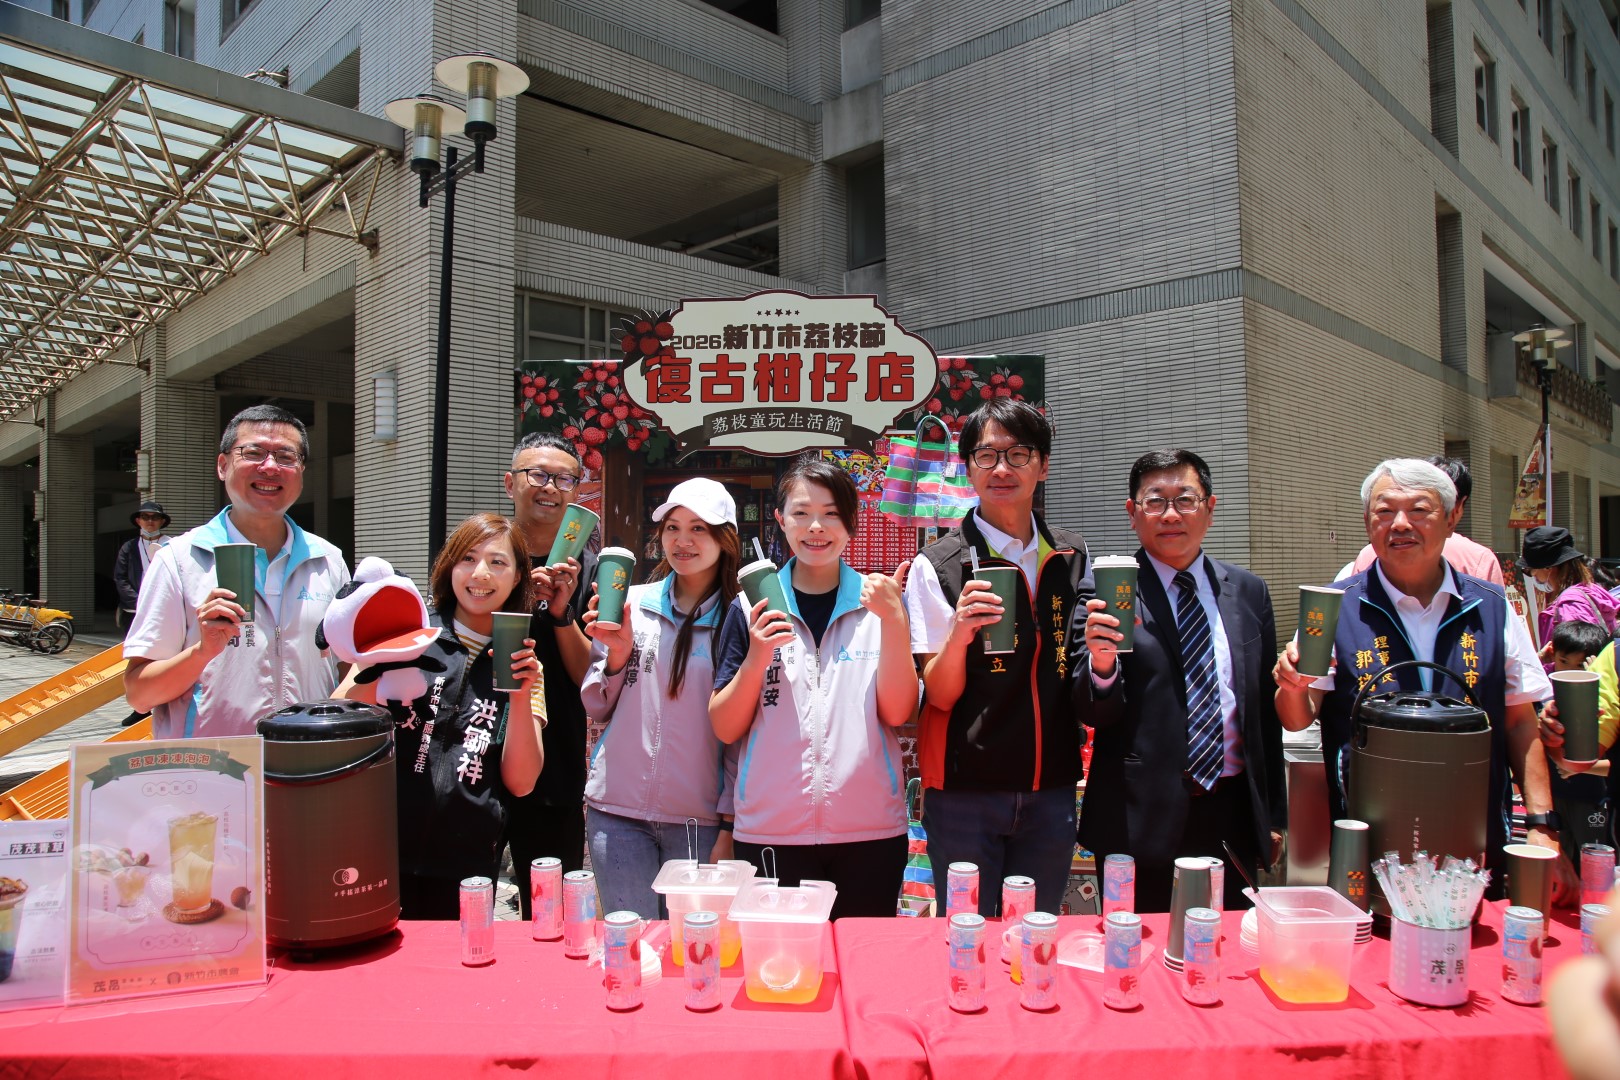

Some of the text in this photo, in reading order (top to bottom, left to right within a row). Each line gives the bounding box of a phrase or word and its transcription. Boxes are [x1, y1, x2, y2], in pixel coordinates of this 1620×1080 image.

[670, 322, 886, 350] 2026新竹市荔枝節
[644, 352, 915, 403] 復古柑仔店
[711, 412, 844, 434] 荔枝童玩生活節
[1460, 632, 1480, 704] 新竹市
[414, 676, 446, 773] 新竹市服務處主任
[457, 698, 499, 785] 洪毓祥
[127, 752, 211, 769] 荔夏凍凍泡泡
